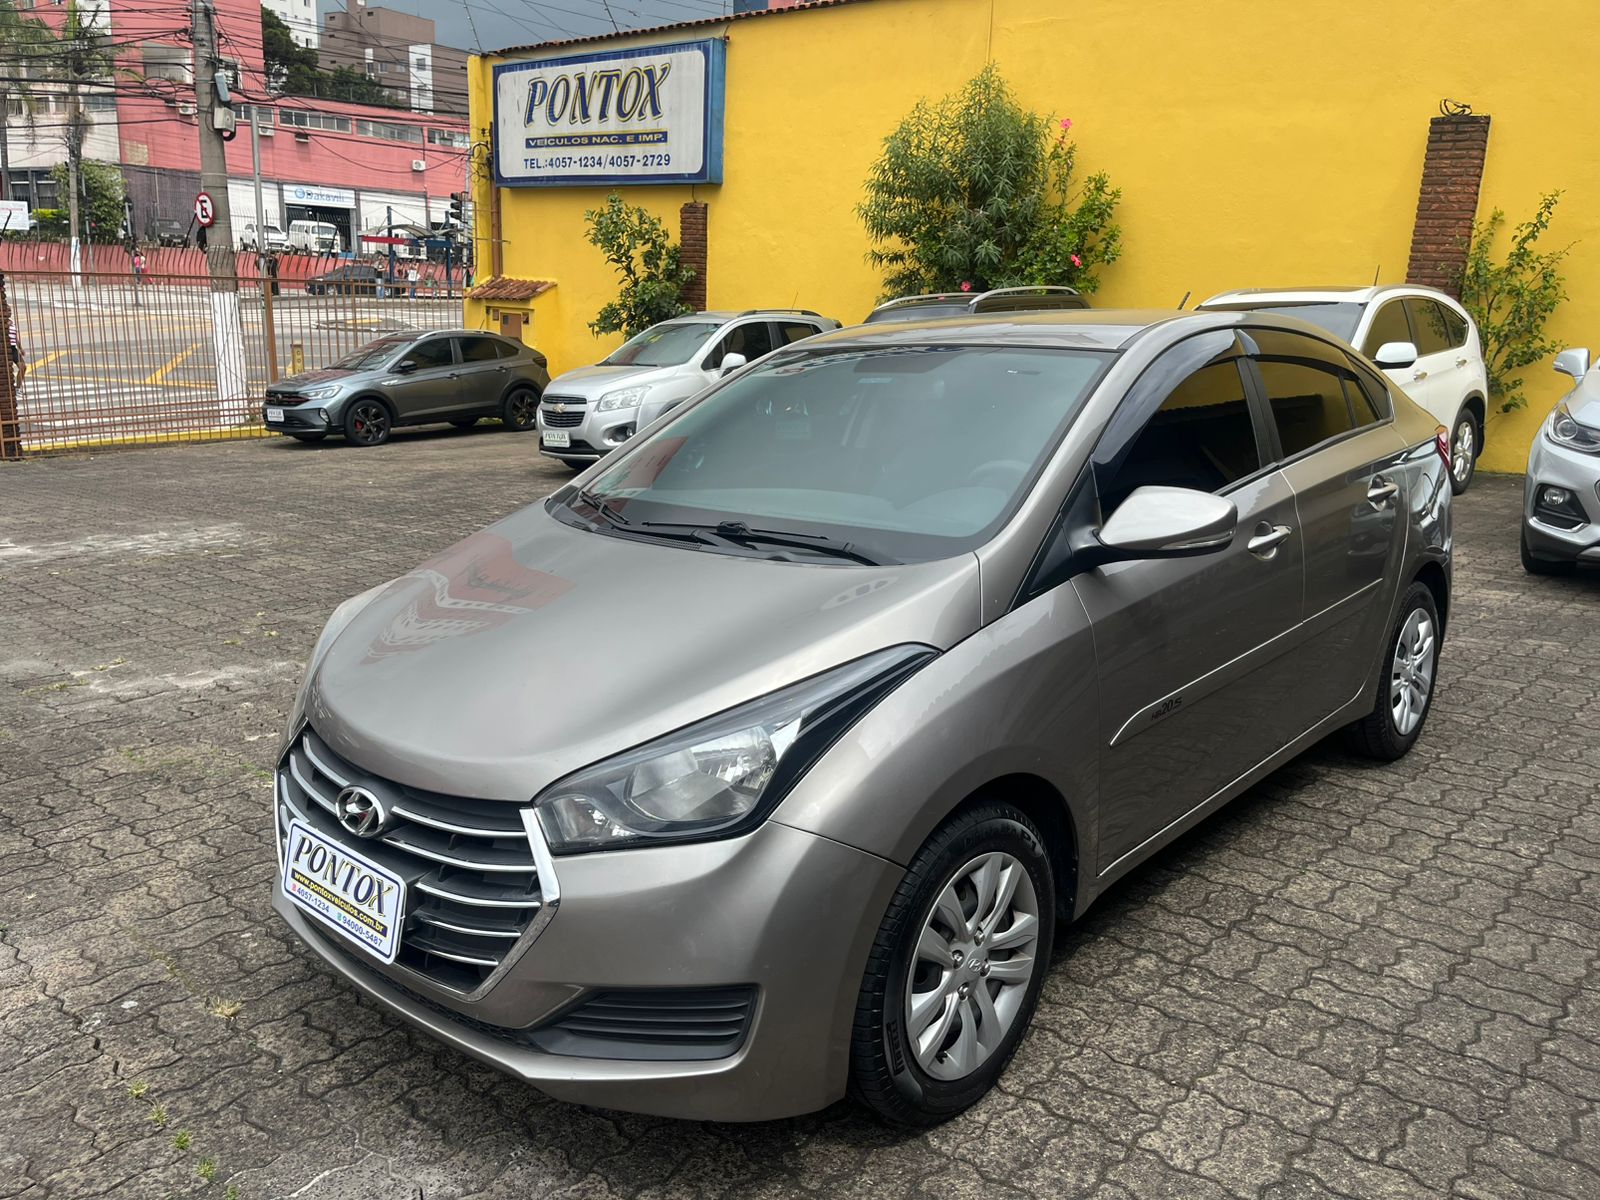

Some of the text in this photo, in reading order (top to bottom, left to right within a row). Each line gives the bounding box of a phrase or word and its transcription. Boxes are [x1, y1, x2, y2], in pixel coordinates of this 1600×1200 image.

[524, 63, 671, 128] PONTOX
[592, 135, 622, 144] NAC.
[626, 134, 635, 143] E
[639, 133, 665, 142] IMP.
[293, 834, 394, 918] PONTOX
[294, 871, 384, 932] www.pontoxveiculos.com.br
[296, 887, 383, 946] 4057-1234 94000-5487
